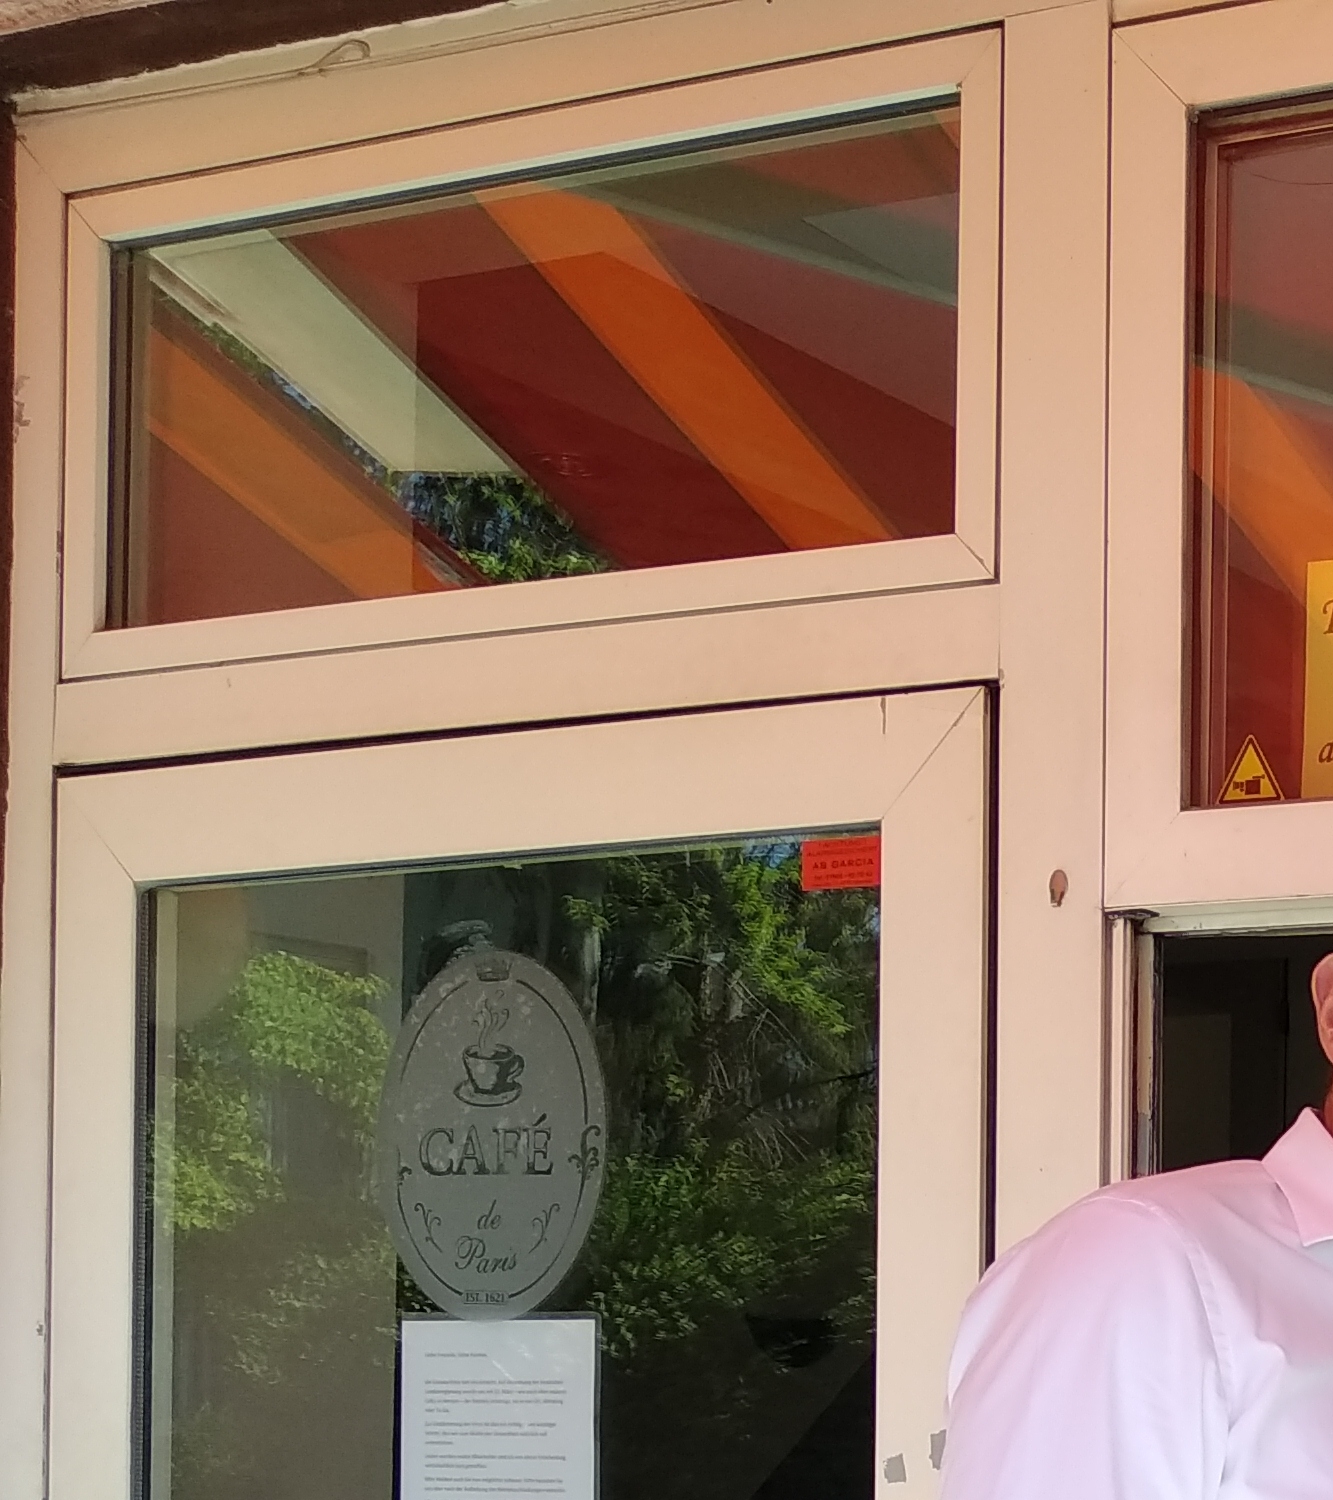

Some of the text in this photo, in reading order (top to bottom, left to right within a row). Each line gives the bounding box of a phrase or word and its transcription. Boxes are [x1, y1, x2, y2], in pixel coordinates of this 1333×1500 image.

[419, 1113, 554, 1176] CAFÉ
[477, 1199, 502, 1232] de
[454, 1235, 519, 1274] Paris
